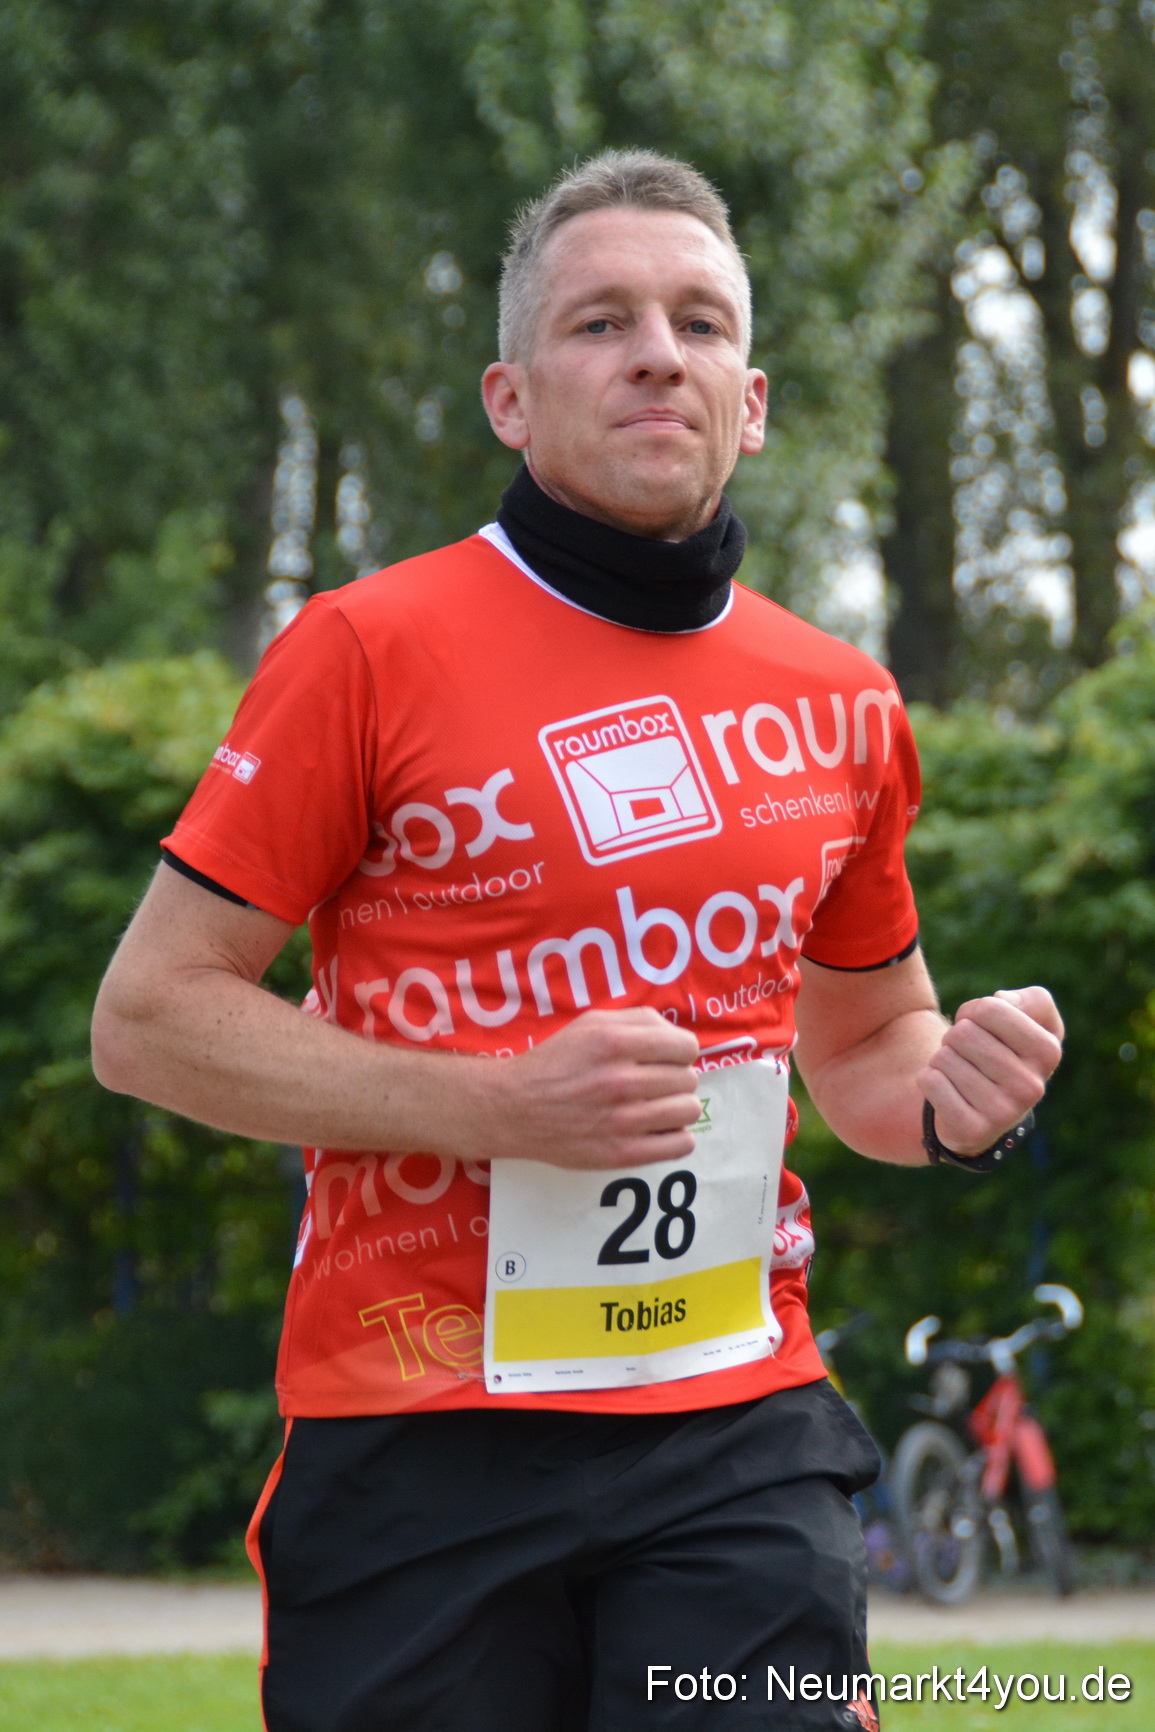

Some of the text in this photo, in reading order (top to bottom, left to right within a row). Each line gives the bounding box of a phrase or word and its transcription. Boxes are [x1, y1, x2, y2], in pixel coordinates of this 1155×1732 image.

[553, 711, 674, 760] raumbox
[412, 860, 545, 911] outdoor
[353, 877, 804, 1043] raumbox
[597, 1169, 698, 1266] 28
[504, 1259, 517, 1276] B
[600, 1298, 687, 1332] Tobias
